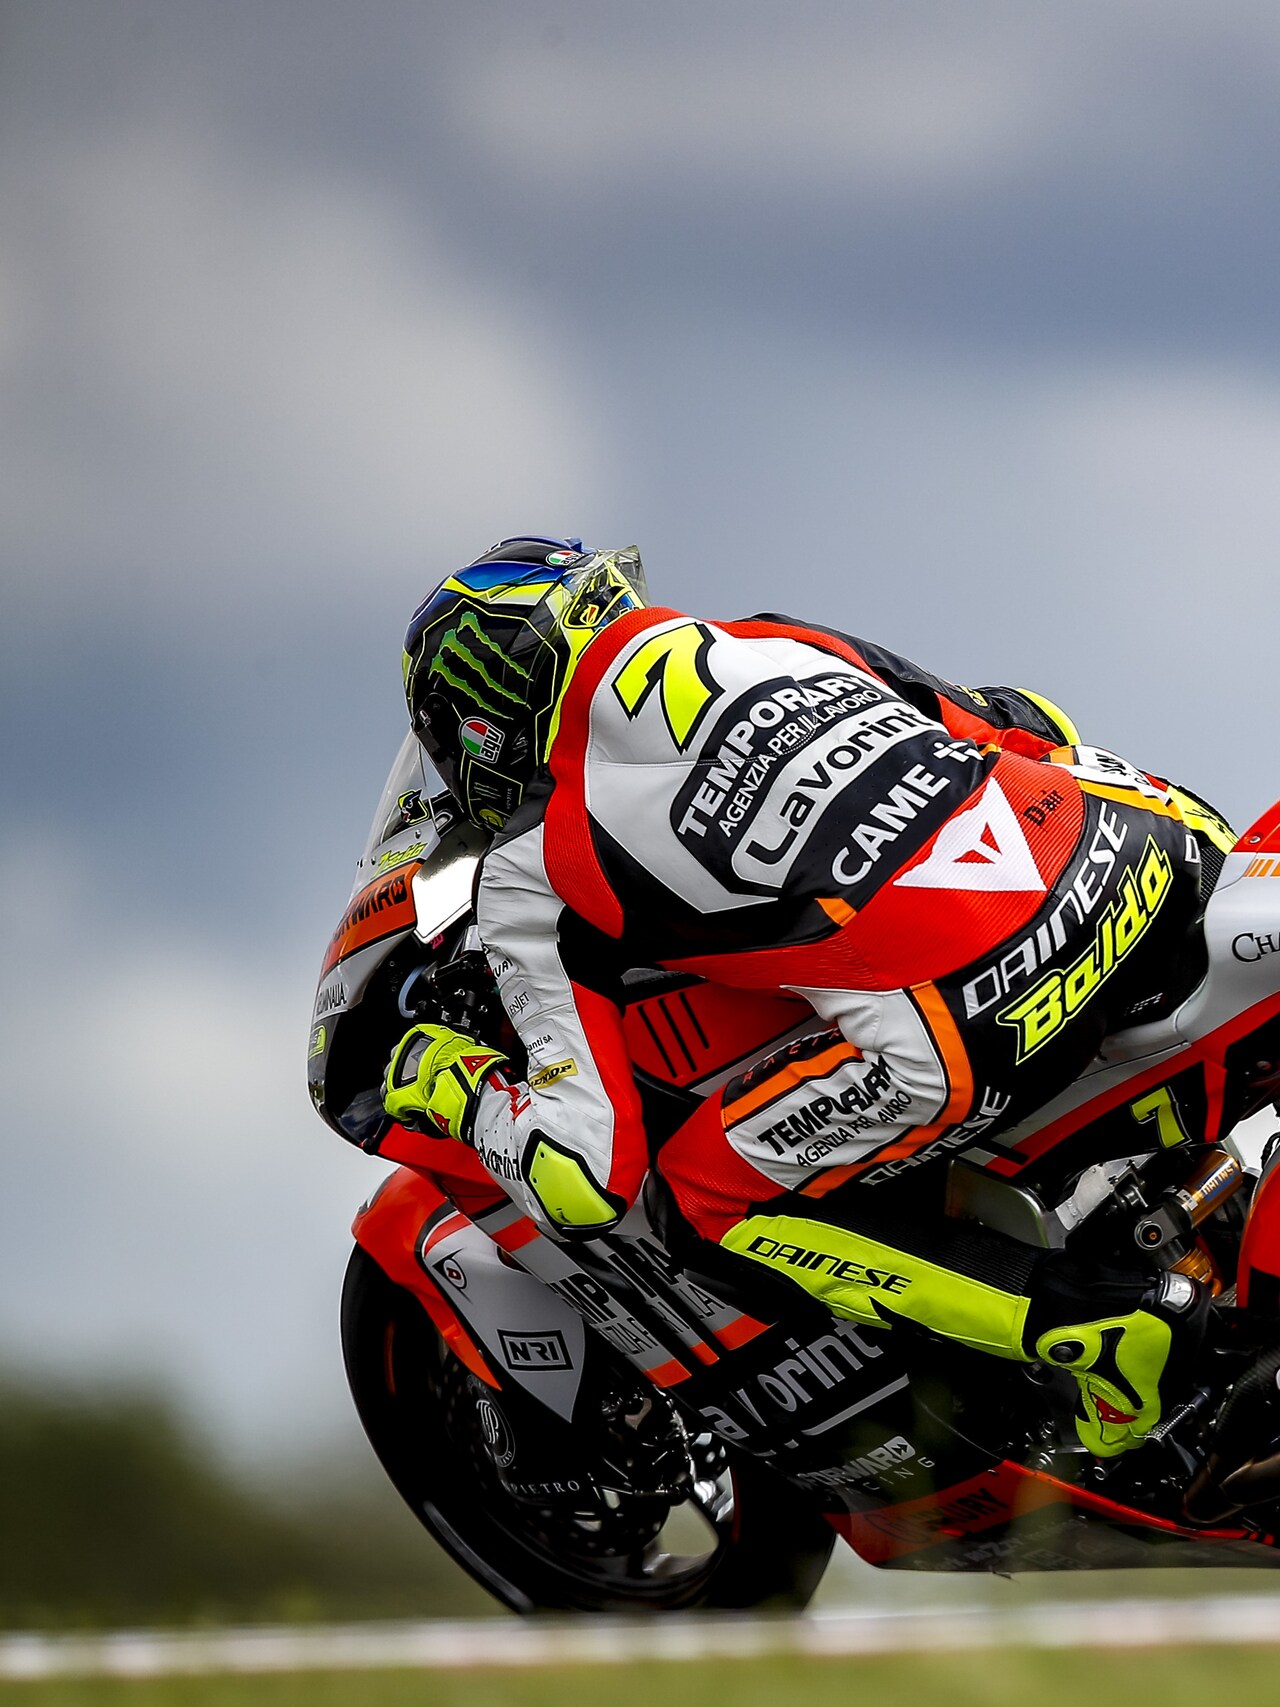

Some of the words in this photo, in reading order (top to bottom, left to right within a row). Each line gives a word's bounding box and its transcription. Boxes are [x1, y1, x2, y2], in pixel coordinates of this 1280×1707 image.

[611, 622, 726, 755] 7
[677, 676, 872, 838] TEMPORARY
[718, 754, 777, 838] AGENZIA
[767, 722, 807, 755] PER
[812, 689, 882, 723] LAVORO
[745, 707, 934, 866] Lavorint
[832, 763, 950, 885] CAME
[962, 801, 1128, 1020] DAINESE
[796, 1127, 854, 1167] AGENZIA
[1130, 1085, 1192, 1149] 7
[745, 1235, 913, 1295] DAINESE
[508, 1340, 560, 1361] NRI
